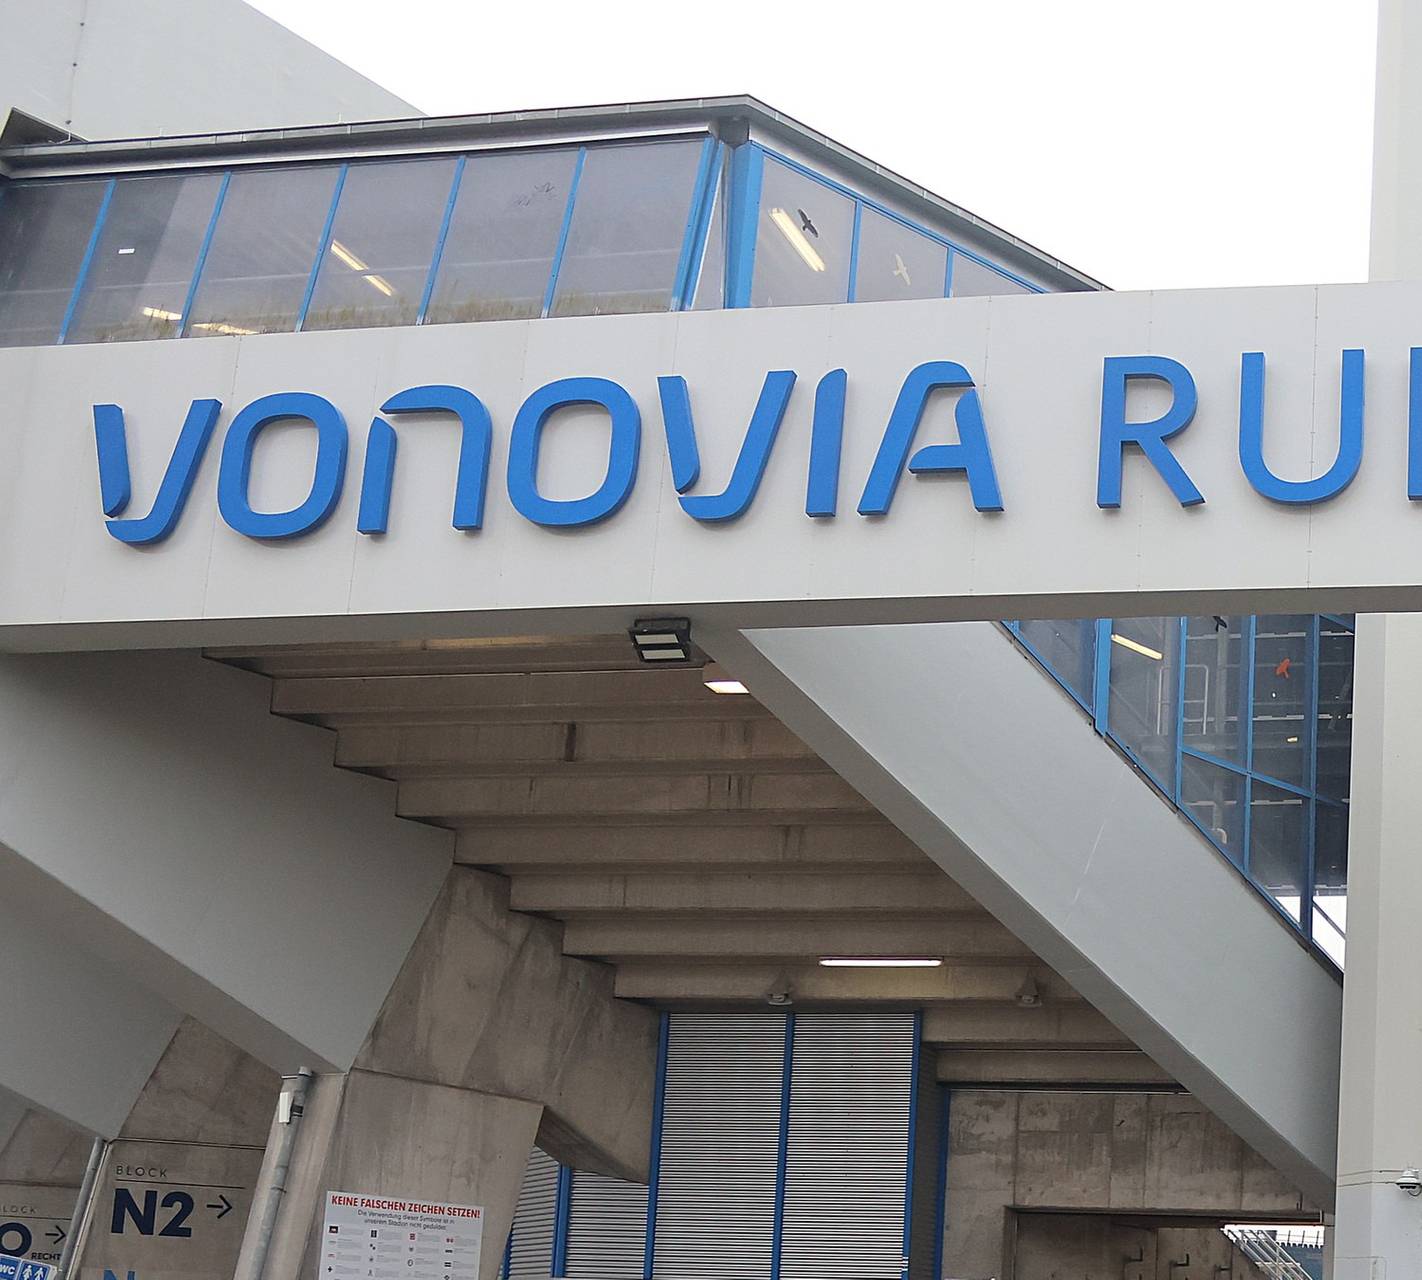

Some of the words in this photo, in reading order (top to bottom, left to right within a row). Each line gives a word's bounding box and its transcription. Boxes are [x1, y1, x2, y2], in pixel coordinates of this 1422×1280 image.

[93, 361, 1005, 546] VONOVIA
[116, 1166, 168, 1178] BLOCK
[1, 1204, 36, 1214] LOCK
[332, 1195, 358, 1207] KEINE
[360, 1198, 406, 1212] FALSCHEN
[408, 1203, 445, 1216] ZEICHEN
[447, 1206, 480, 1219] SETZEN!
[111, 1188, 194, 1238] N2
[388, 1220, 408, 1228] Stadion
[31, 1252, 62, 1261] RECHT
[0, 1264, 16, 1275] WC
